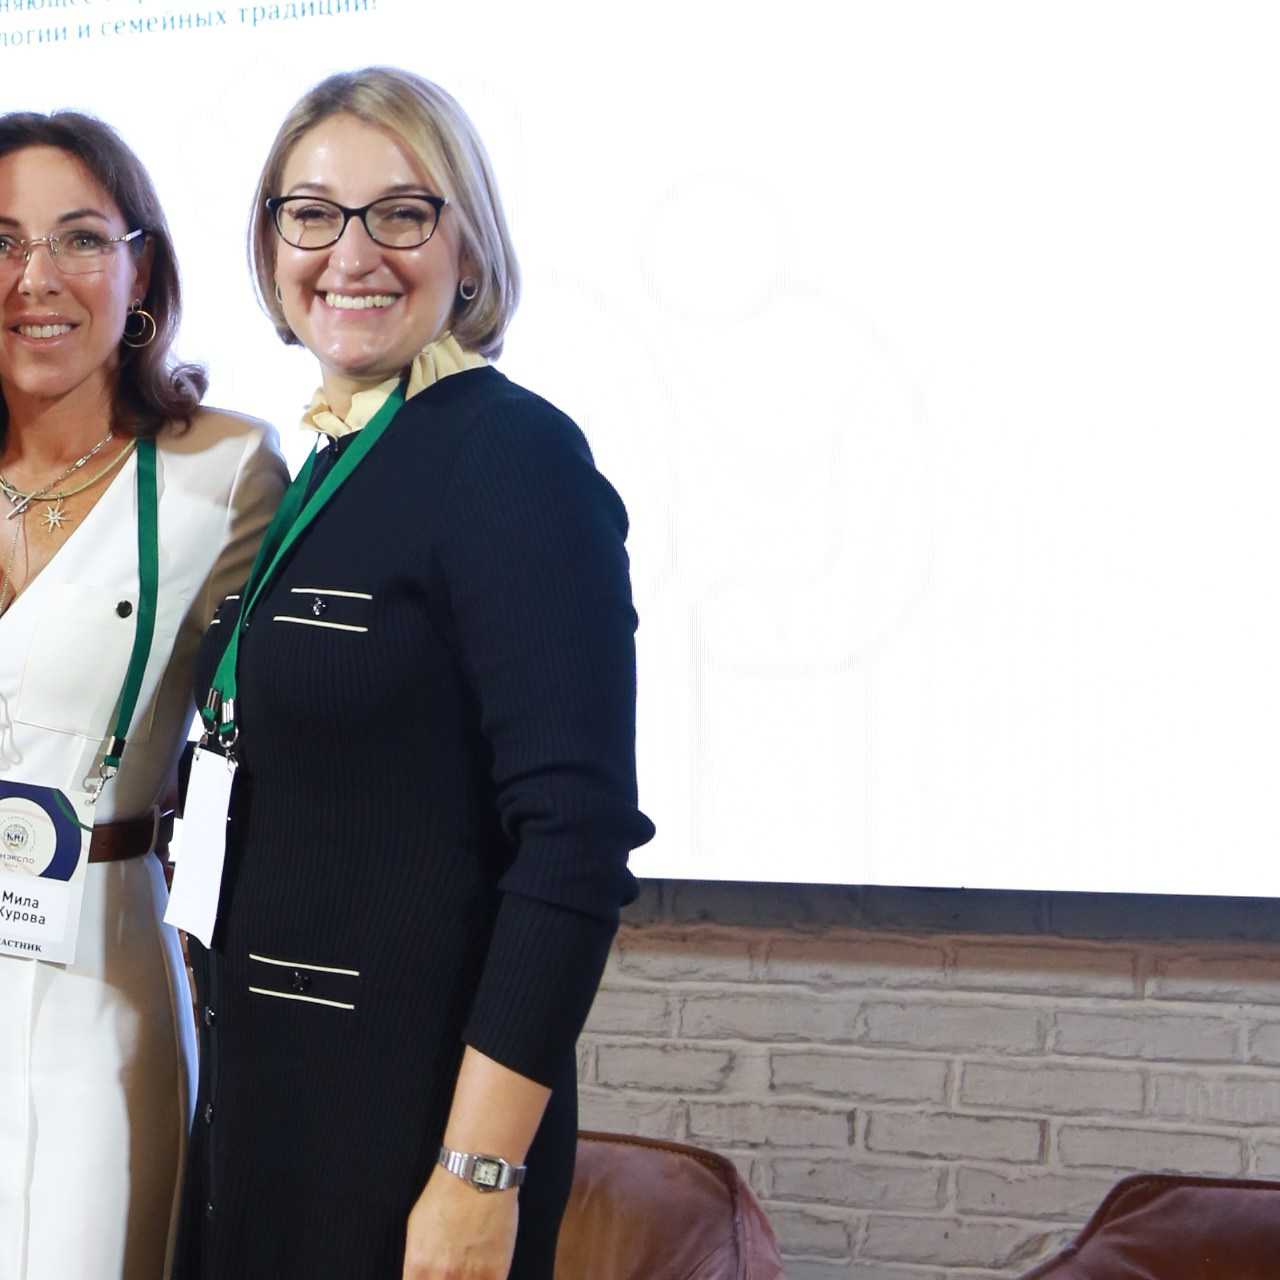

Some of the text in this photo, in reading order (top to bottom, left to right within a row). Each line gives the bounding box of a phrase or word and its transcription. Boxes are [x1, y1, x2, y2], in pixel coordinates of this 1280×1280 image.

[78, 23, 91, 39] и
[100, 10, 227, 36] семейных
[2, 890, 39, 909] Мила
